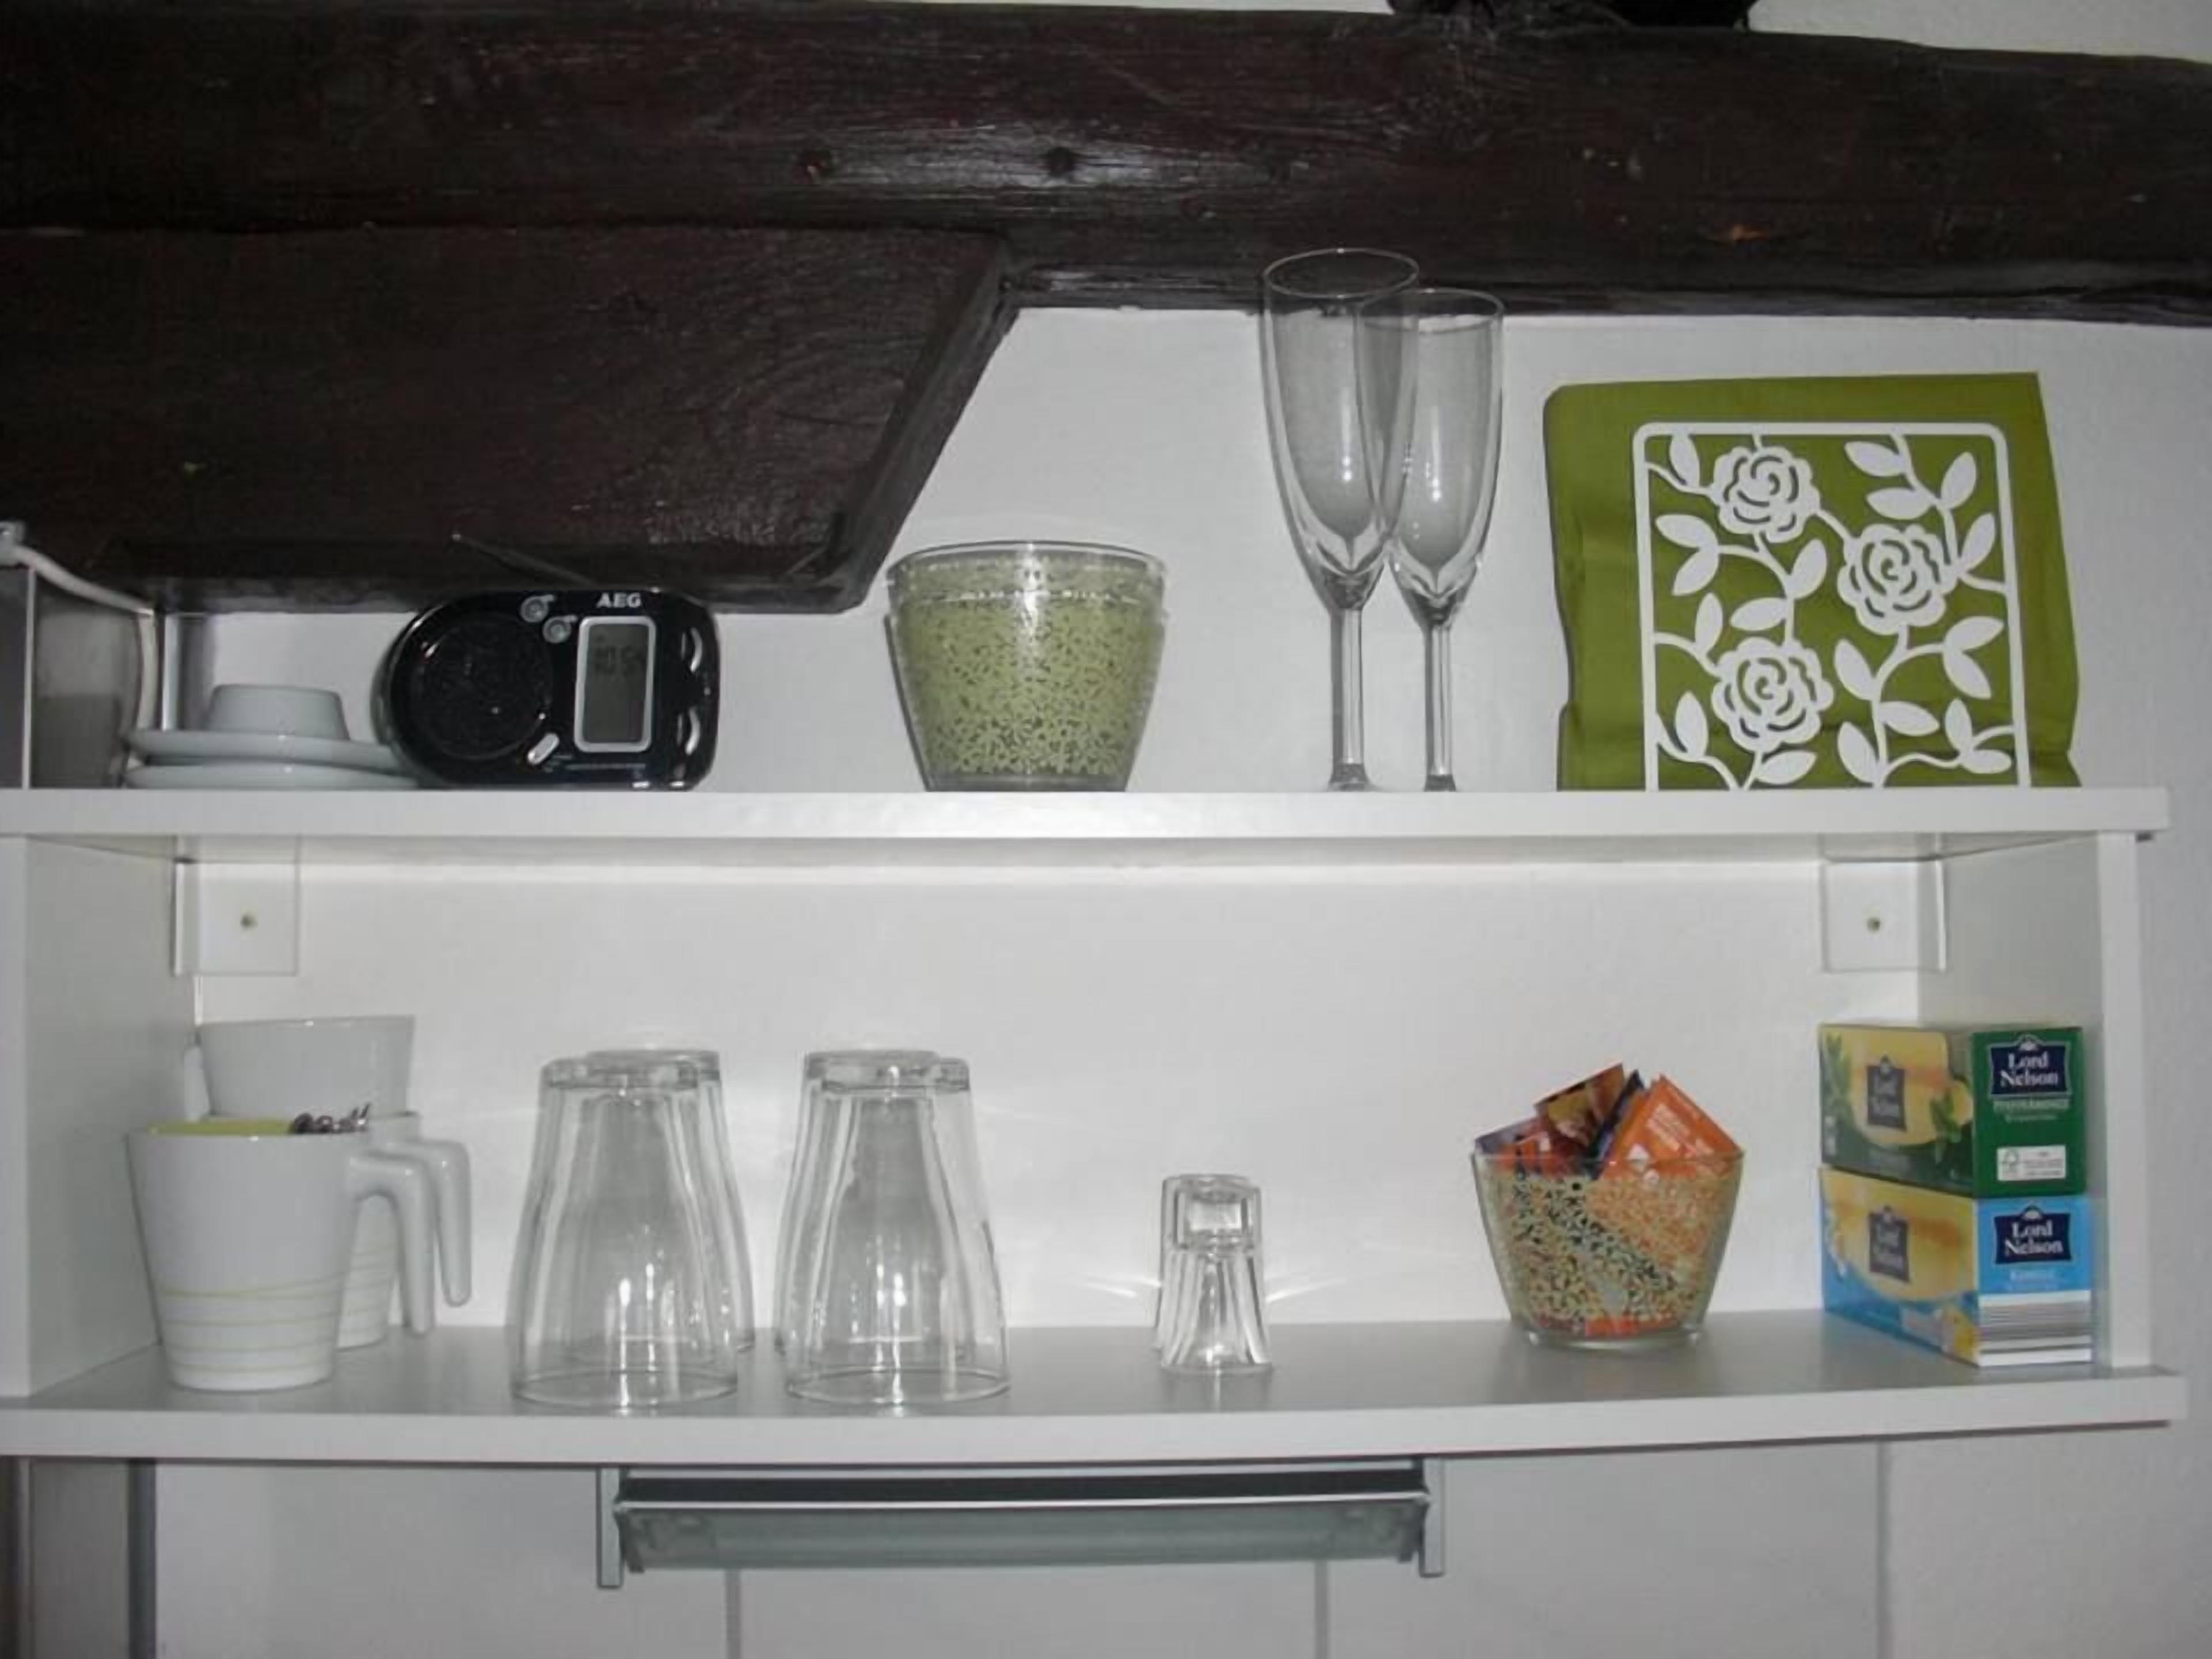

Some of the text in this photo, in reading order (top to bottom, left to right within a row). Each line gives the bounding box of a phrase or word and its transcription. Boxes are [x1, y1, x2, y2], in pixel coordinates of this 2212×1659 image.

[596, 592, 641, 608] AEG
[2008, 1051, 2049, 1069] Lord
[2000, 1069, 2059, 1087] Nelson
[2012, 1220, 2053, 1238] Lord
[2005, 1238, 2064, 1256] Nelson
